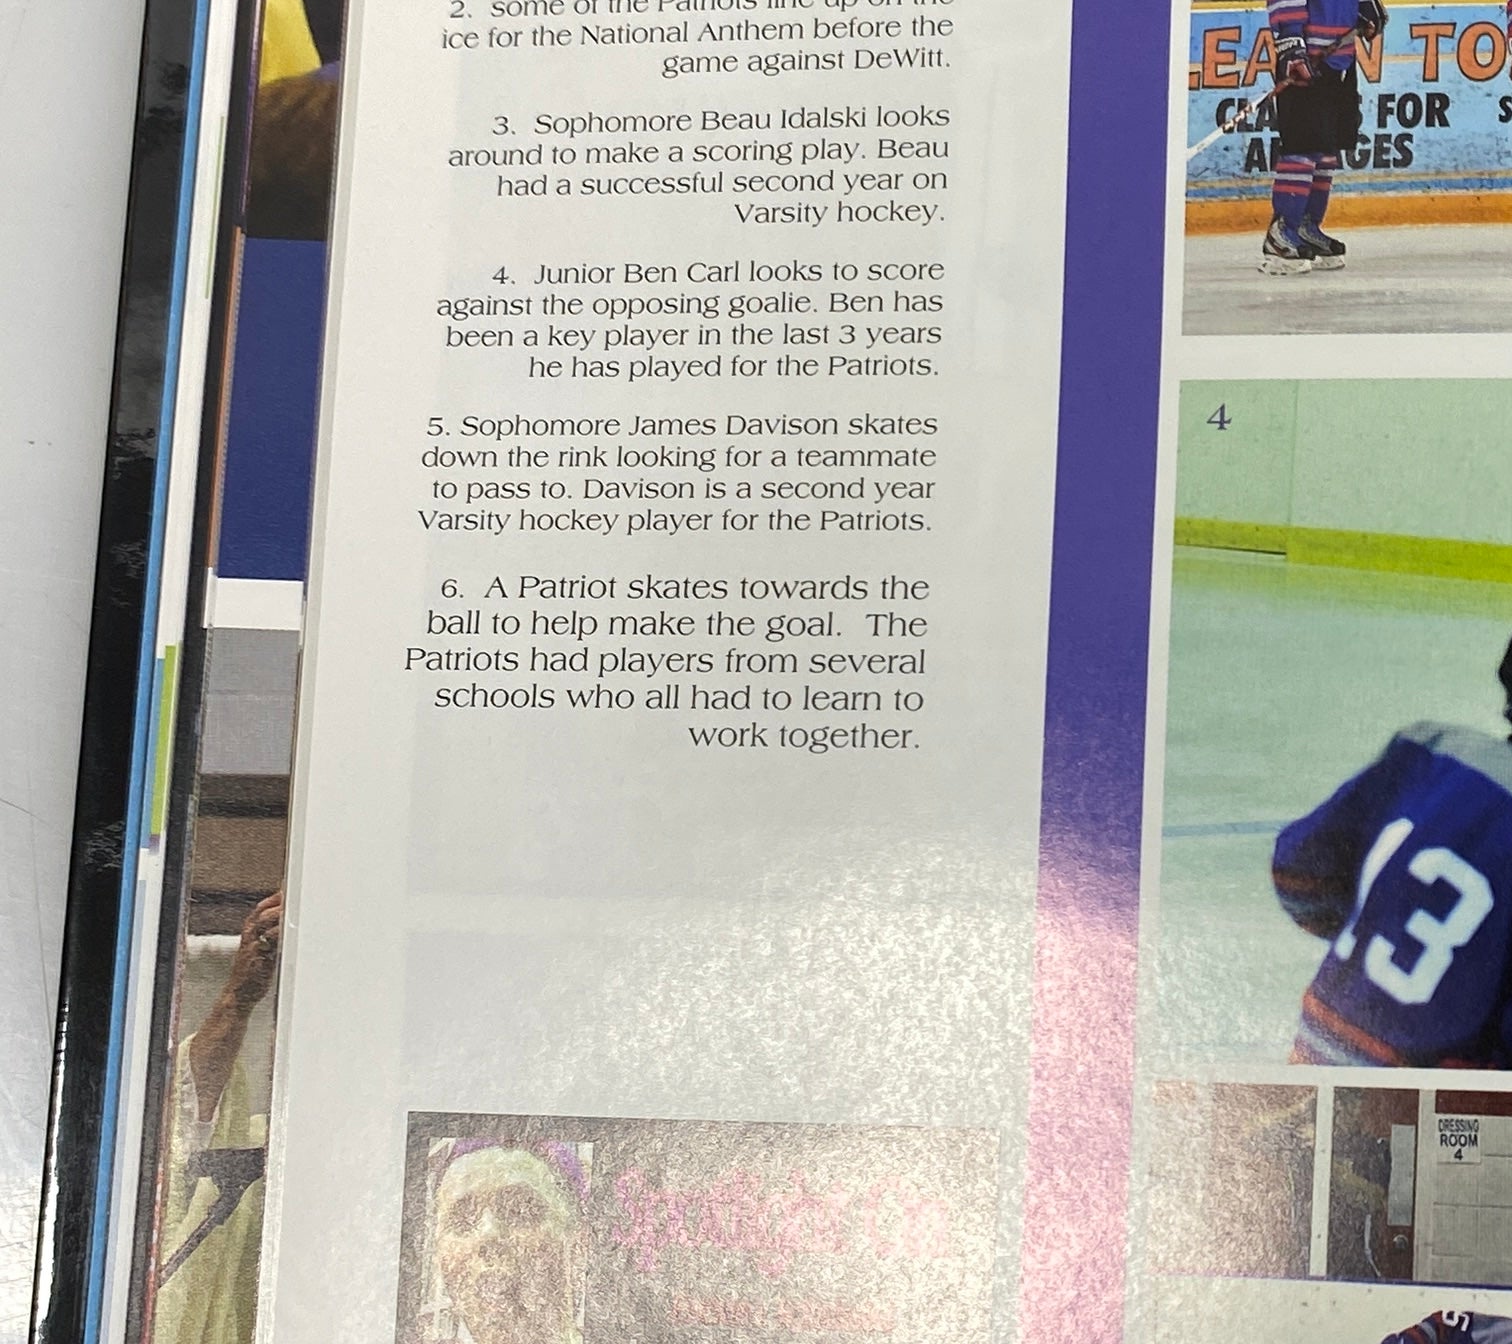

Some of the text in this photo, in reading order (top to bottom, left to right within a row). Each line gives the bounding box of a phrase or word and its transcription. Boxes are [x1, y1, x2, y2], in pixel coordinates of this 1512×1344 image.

[1409, 21, 1506, 82] TO
[490, 103, 951, 140] 3. Sophomore Beau Idalski looks
[1377, 92, 1451, 129] FOR
[447, 137, 949, 168] around to make a scoring play. Beau
[496, 168, 948, 197] had a successful second year on
[733, 199, 945, 229] Varsity hockey.
[1206, 402, 1233, 431] 4
[440, 573, 930, 602] 6. A Patriot skates towards the
[426, 609, 929, 644] ball to help make the goal. The
[402, 642, 926, 681] Patriots had players from several
[433, 678, 925, 713] schools who all had to learn to
[687, 721, 920, 755] work together.
[1335, 817, 1495, 1005] 13
[1440, 1133, 1479, 1148] ROOM
[1453, 1148, 1464, 1161] 4
